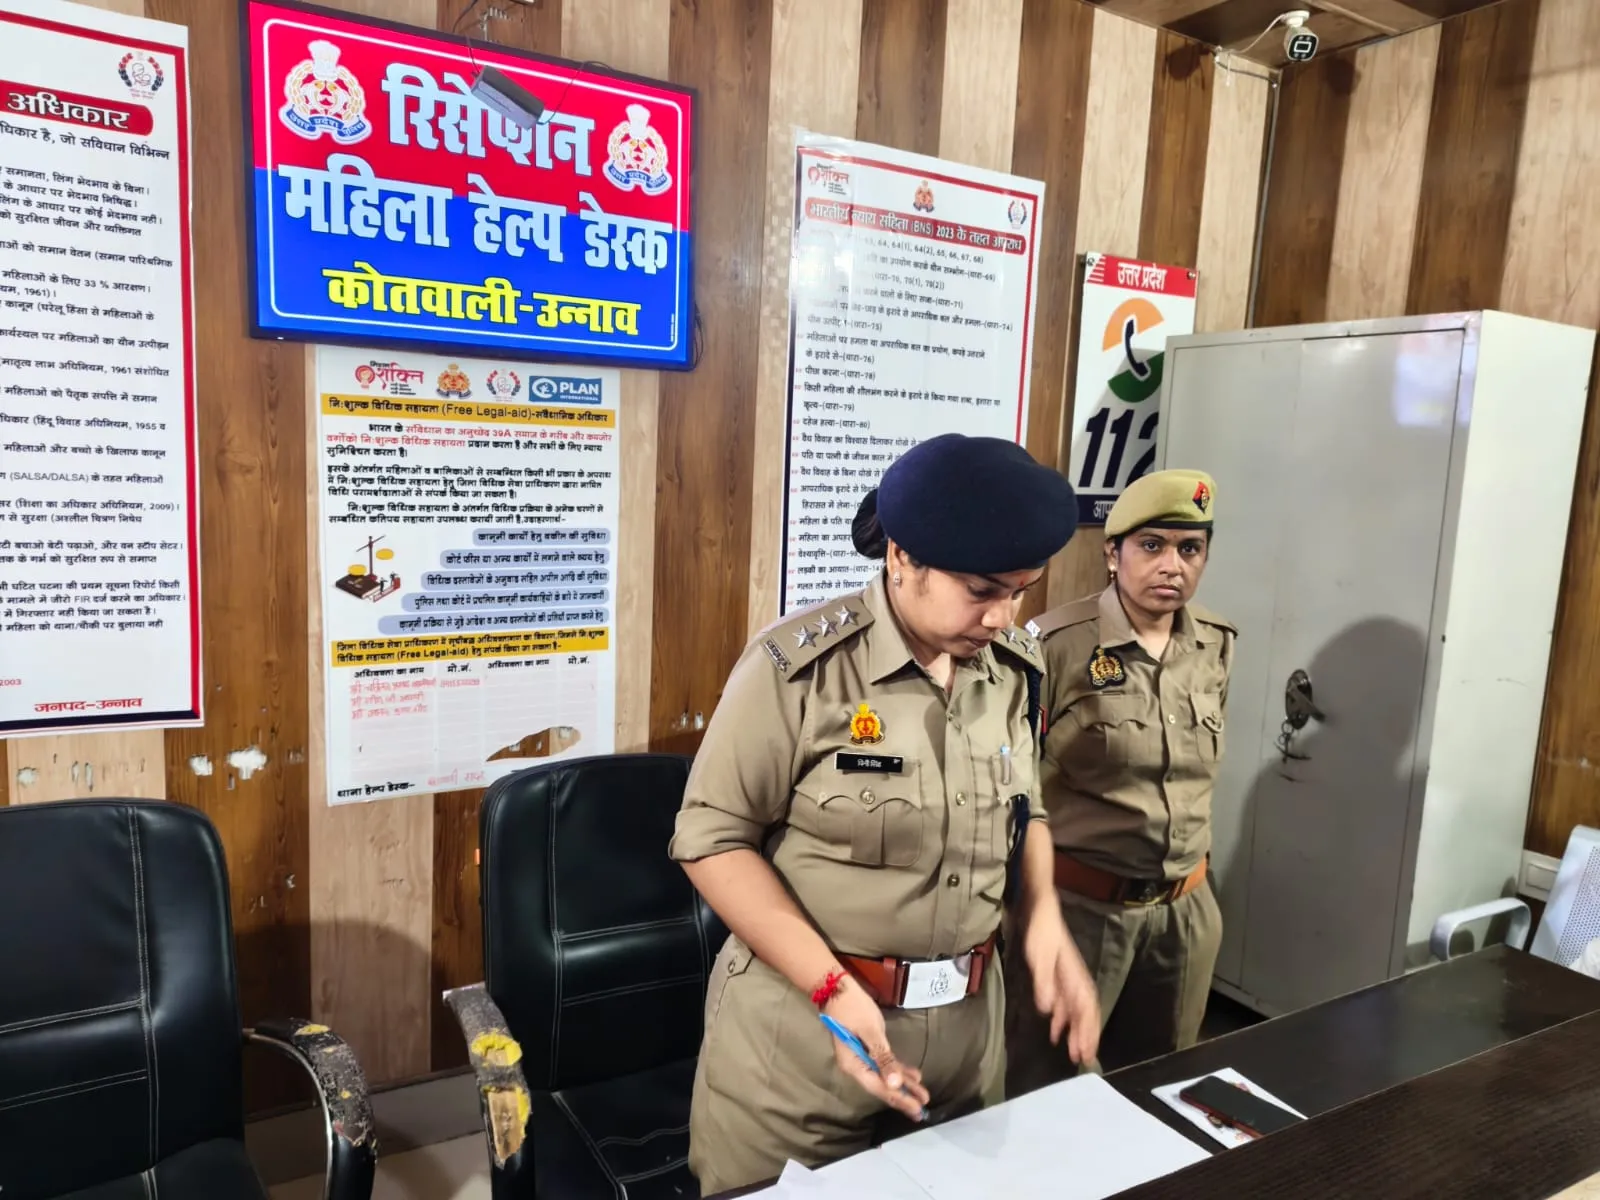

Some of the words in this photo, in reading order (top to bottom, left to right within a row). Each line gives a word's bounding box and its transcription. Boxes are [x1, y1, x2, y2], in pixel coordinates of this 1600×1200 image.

[7, 91, 130, 128] अधिकार
[39, 127, 55, 144] है,
[59, 131, 76, 145] जो
[129, 142, 170, 160] विभिन्न
[4, 166, 49, 181] समानता,
[76, 175, 109, 189] भेदभाव
[111, 180, 121, 190] के
[16, 183, 47, 195] आधार
[49, 188, 63, 197] पर
[66, 187, 99, 202] भेदभाव
[67, 205, 81, 214] पर
[278, 153, 452, 248] महिला
[467, 173, 566, 262] हेल्प
[578, 191, 673, 275] डेस्क
[14, 211, 49, 224] सुरक्षित
[52, 215, 80, 228] जीवन
[83, 219, 101, 231] और
[911, 219, 934, 236] (BNS)
[935, 224, 954, 239] 2023
[956, 225, 967, 240] के
[968, 231, 990, 245] तहत
[37, 244, 67, 255] समान
[913, 244, 935, 256] 64(2),
[61, 273, 81, 286] लिए
[84, 279, 96, 287] 33
[1117, 261, 1140, 286] उत्तर
[1140, 263, 1167, 291] प्रदेश
[322, 261, 641, 335] कोतवाली-उन्नाव
[4, 299, 34, 312] कानून
[90, 305, 100, 316] से
[41, 332, 55, 340] पर
[102, 337, 115, 345] का
[117, 336, 135, 346] यौन
[33, 360, 55, 368] लाभ
[110, 365, 131, 374] 1961
[64, 387, 88, 401] पैतृक
[131, 394, 157, 402] समान
[559, 382, 599, 395] PLAN
[404, 403, 439, 413] सहायता
[441, 403, 472, 416] (Free
[576, 411, 608, 421] अधिकार
[55, 415, 81, 427] विवाह
[135, 422, 157, 430] 1955
[368, 423, 392, 432] भारत
[393, 422, 403, 432] के
[458, 426, 490, 437] अनुच्छेद
[49, 443, 68, 453] और
[140, 449, 166, 459] कानून
[491, 440, 513, 448] करता
[522, 439, 537, 449] और
[372, 448, 396, 456] करता
[9, 471, 89, 482] (SALSA/DALSA)
[101, 474, 122, 482] तहत
[408, 478, 440, 486] सहायता
[61, 498, 97, 509] अधिकार
[20, 514, 47, 524] सुरक्षा
[13, 539, 44, 549] बचाओ
[46, 539, 64, 549] बेटी
[29, 552, 46, 562] गर्भ
[63, 553, 96, 565] सुरक्षित
[99, 555, 115, 563] रूप
[128, 555, 157, 563] समाप्त
[11, 580, 35, 590] घटित
[105, 582, 130, 591] सूचना
[132, 579, 156, 589] रिपोर्ट
[158, 579, 180, 588] किसी
[6, 594, 35, 604] मामले
[50, 593, 71, 603] जीरो
[92, 592, 107, 603] दर्ज
[109, 592, 131, 602] करने
[15, 607, 55, 617] गिरफ्तार
[77, 606, 100, 616] किया
[5, 621, 35, 631] महिला
[117, 621, 145, 631] बुलाया
[396, 650, 421, 660] (Free
[423, 647, 468, 658] Legal-aid)
[34, 697, 142, 712] जनपद-उन्नाव
